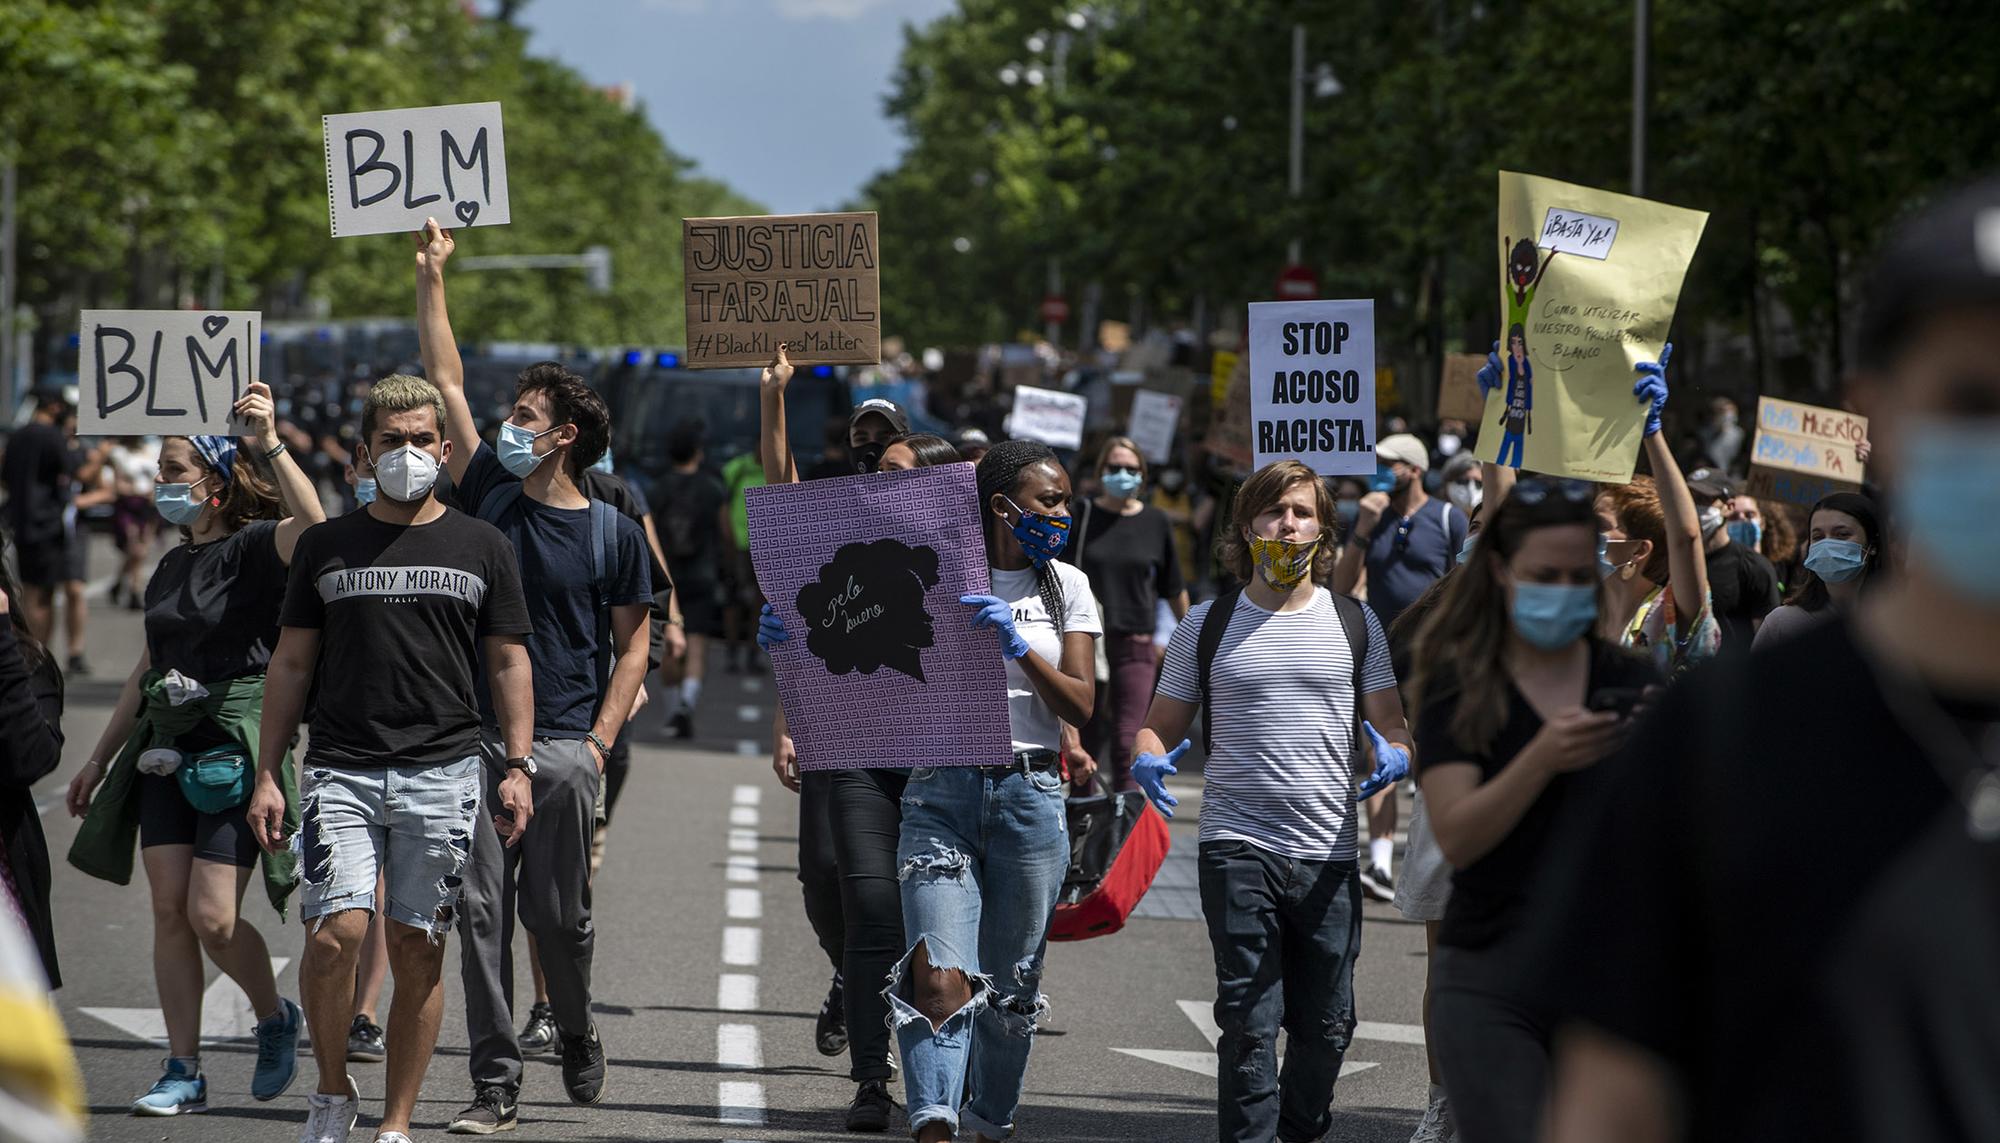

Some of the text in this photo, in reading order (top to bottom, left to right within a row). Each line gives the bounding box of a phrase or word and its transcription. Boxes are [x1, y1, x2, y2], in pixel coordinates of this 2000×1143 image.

[345, 126, 491, 210] BLM
[690, 222, 875, 272] JUSTICIA
[1583, 223, 1612, 247] YA!
[691, 278, 876, 324] TARAJAL
[1282, 321, 1350, 356] STOP
[1271, 369, 1361, 405] ACOSO
[1258, 418, 1373, 454] RACISTA.
[1801, 410, 1864, 442] MUERTO
[1825, 449, 1844, 473] PA
[335, 570, 469, 596] ANTONY MORATO
[383, 596, 419, 604] ITALIA
[1010, 608, 1032, 622] AL
[840, 603, 885, 634] bueno
